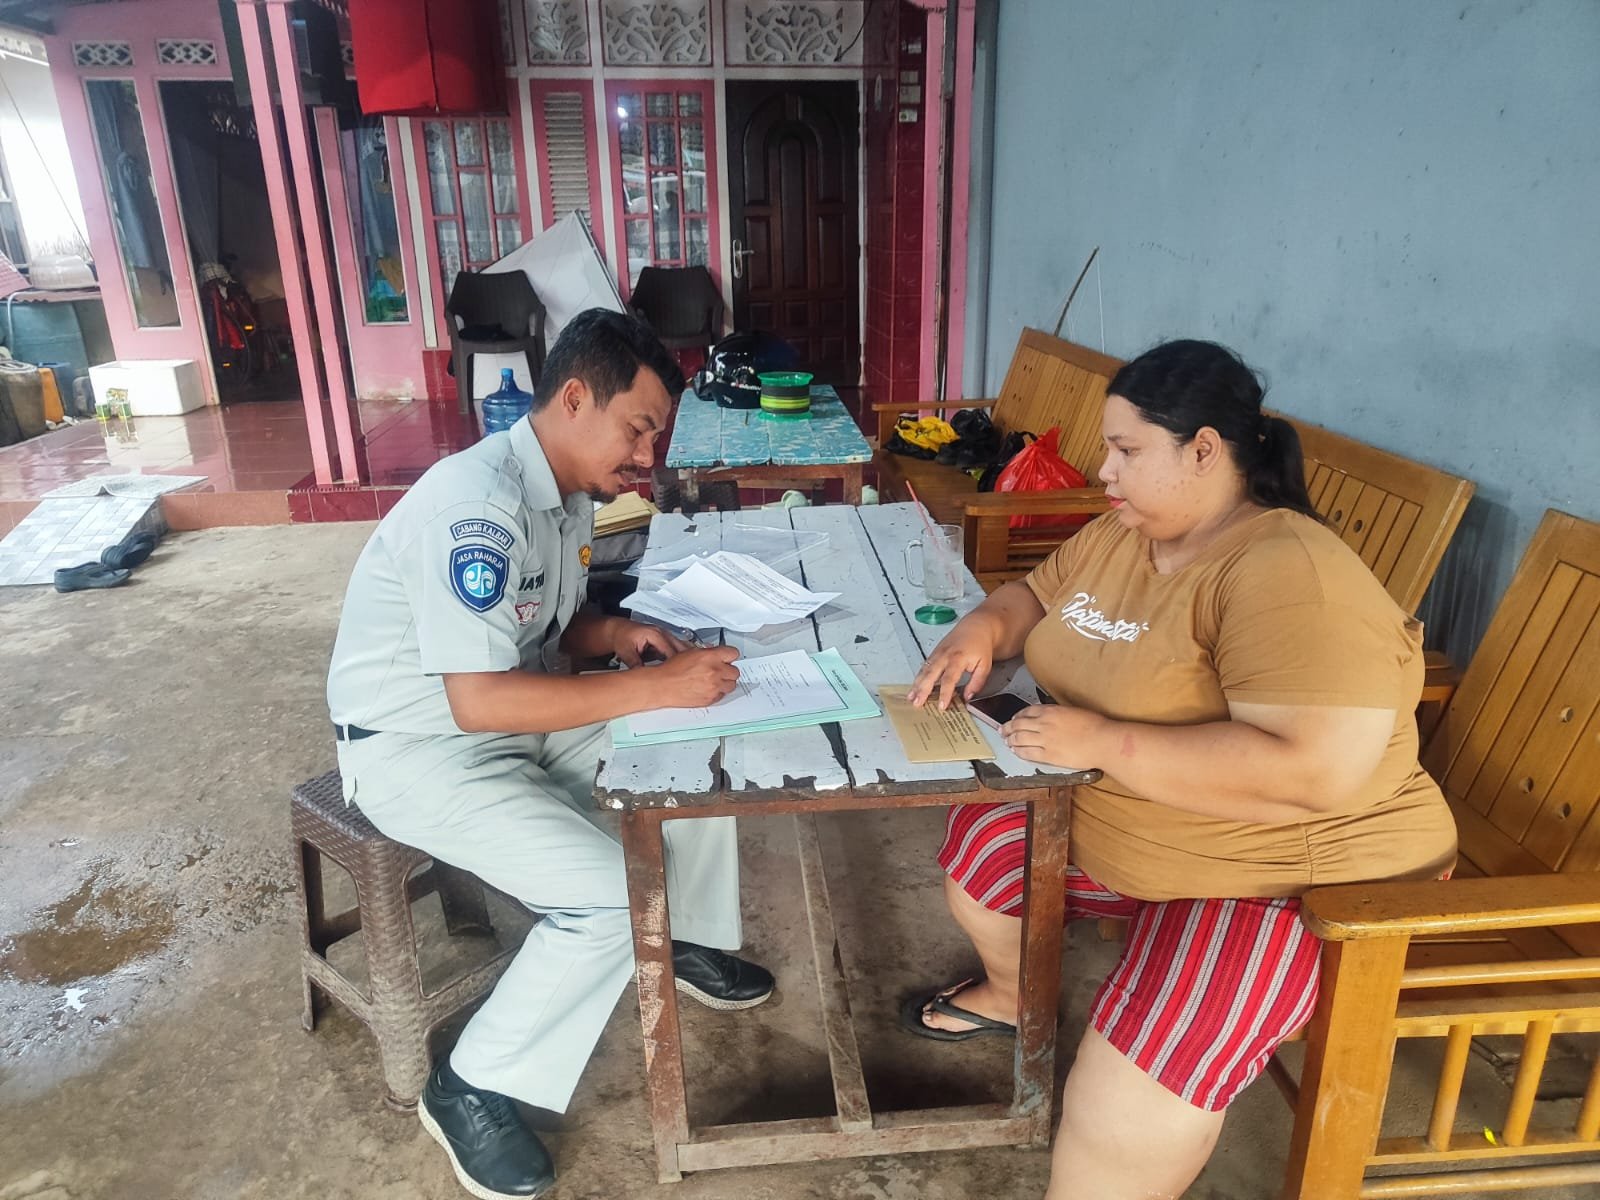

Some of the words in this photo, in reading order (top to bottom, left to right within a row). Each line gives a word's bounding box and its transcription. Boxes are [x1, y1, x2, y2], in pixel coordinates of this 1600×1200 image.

[456, 523, 482, 536] CABANG
[482, 524, 508, 545] KALBAR
[456, 553, 473, 565] JASA
[474, 551, 504, 570] RAHARJA
